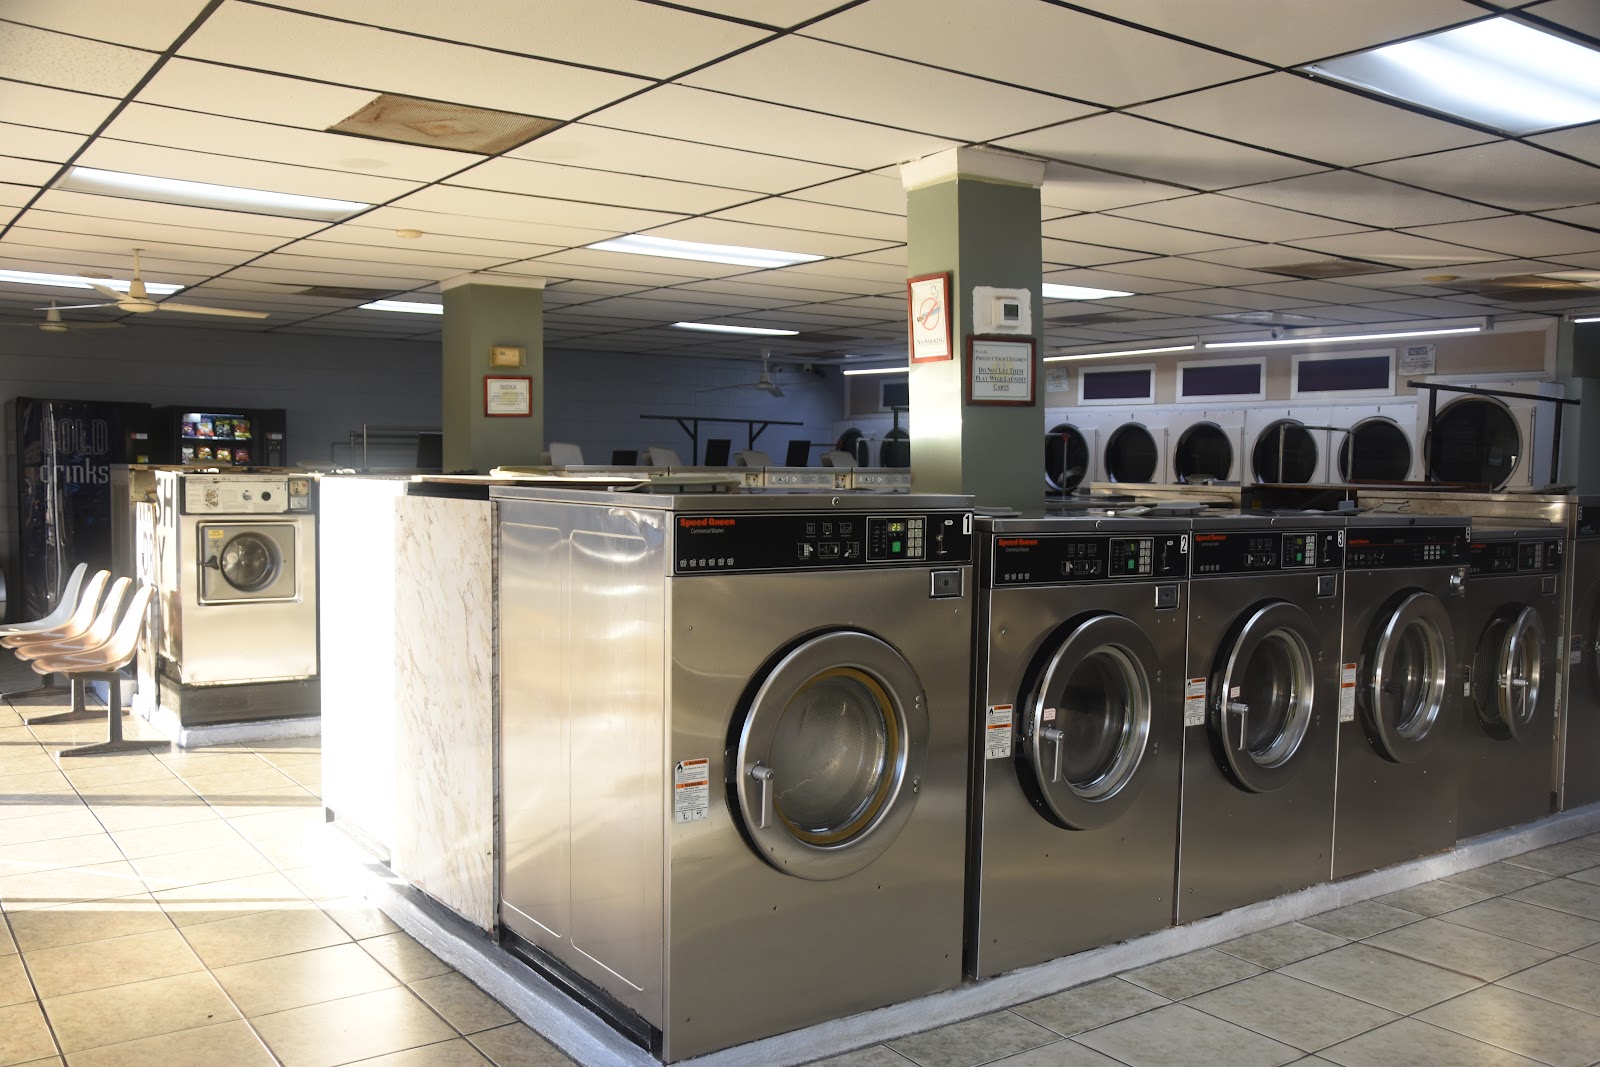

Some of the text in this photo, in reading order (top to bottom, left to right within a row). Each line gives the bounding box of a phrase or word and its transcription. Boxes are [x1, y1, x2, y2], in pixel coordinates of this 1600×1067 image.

[40, 418, 109, 455] COLD
[39, 457, 109, 484] drinks
[680, 517, 736, 527] Speed Queen
[891, 523, 901, 531] 25
[998, 538, 1018, 547] Speed
[1181, 536, 1187, 552] 2
